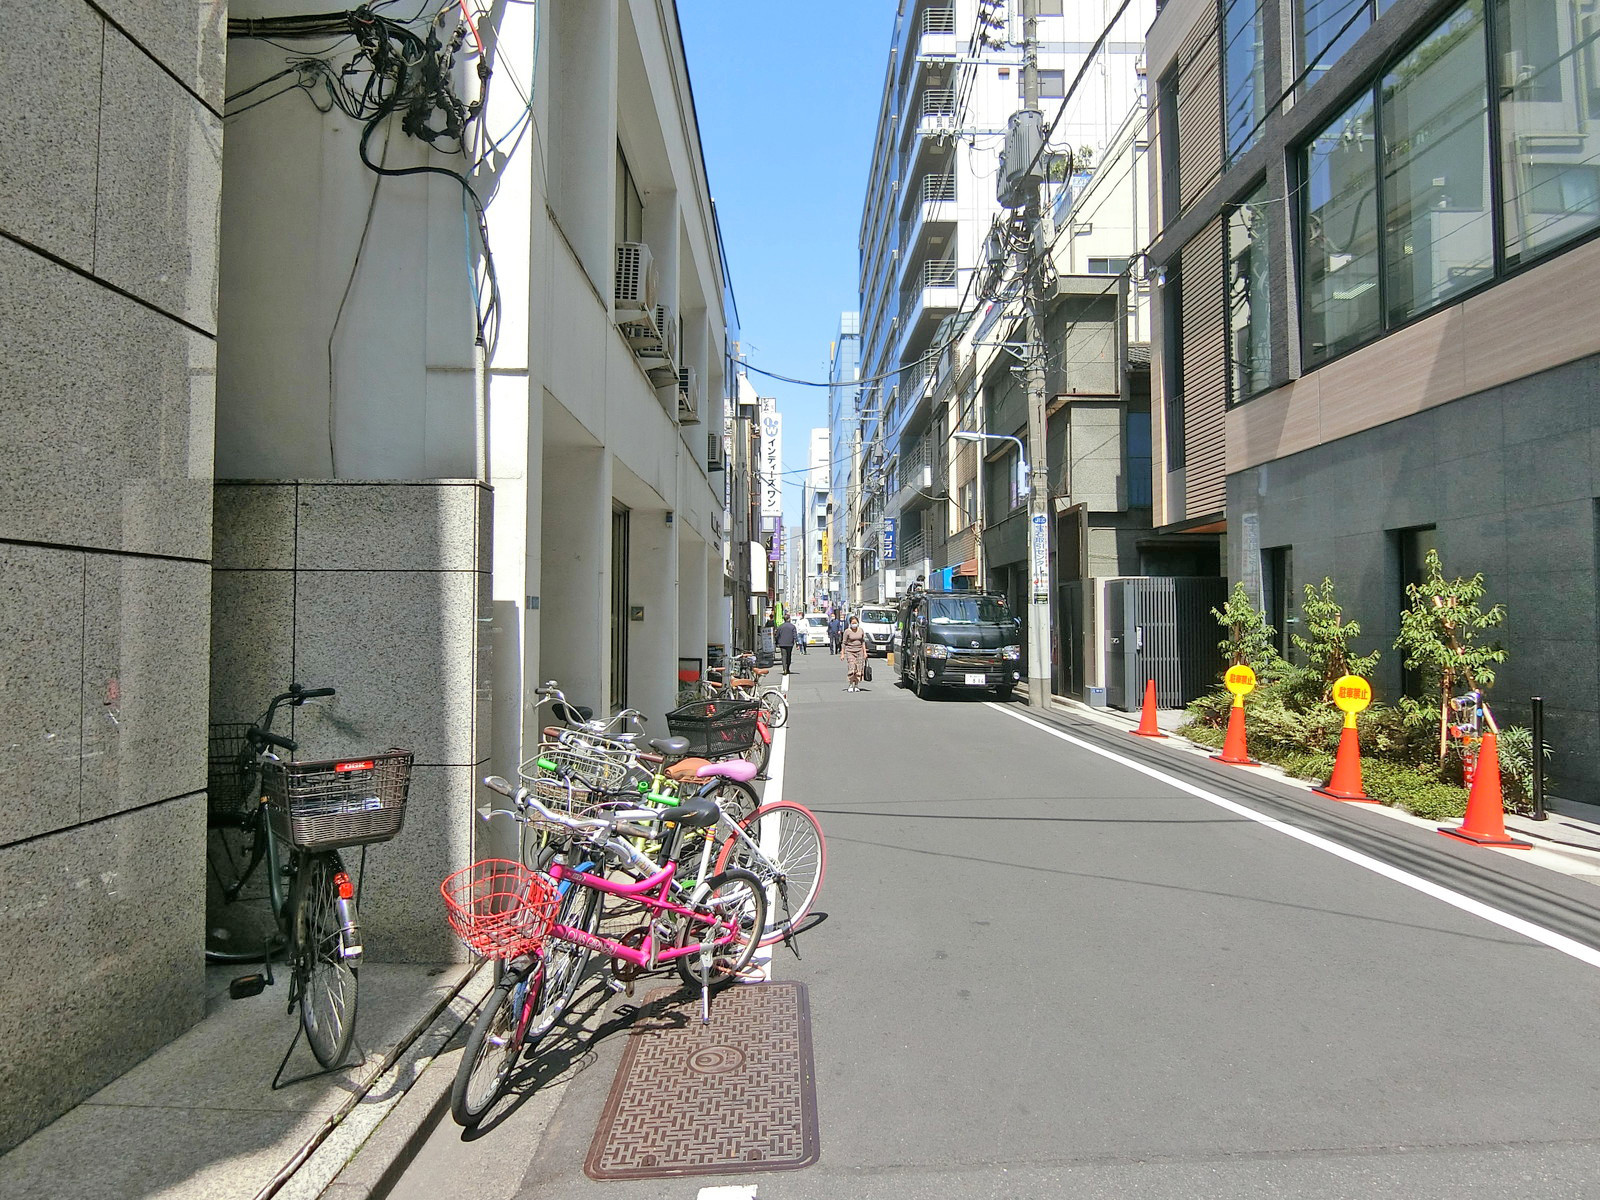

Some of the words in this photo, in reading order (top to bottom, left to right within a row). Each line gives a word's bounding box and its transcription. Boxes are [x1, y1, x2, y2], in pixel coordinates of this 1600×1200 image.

[1229, 673, 1253, 686] 駐車禁止
[1338, 686, 1368, 700] 駐車禁止
[344, 761, 366, 769] OGK
[562, 930, 587, 945] LOUIS
